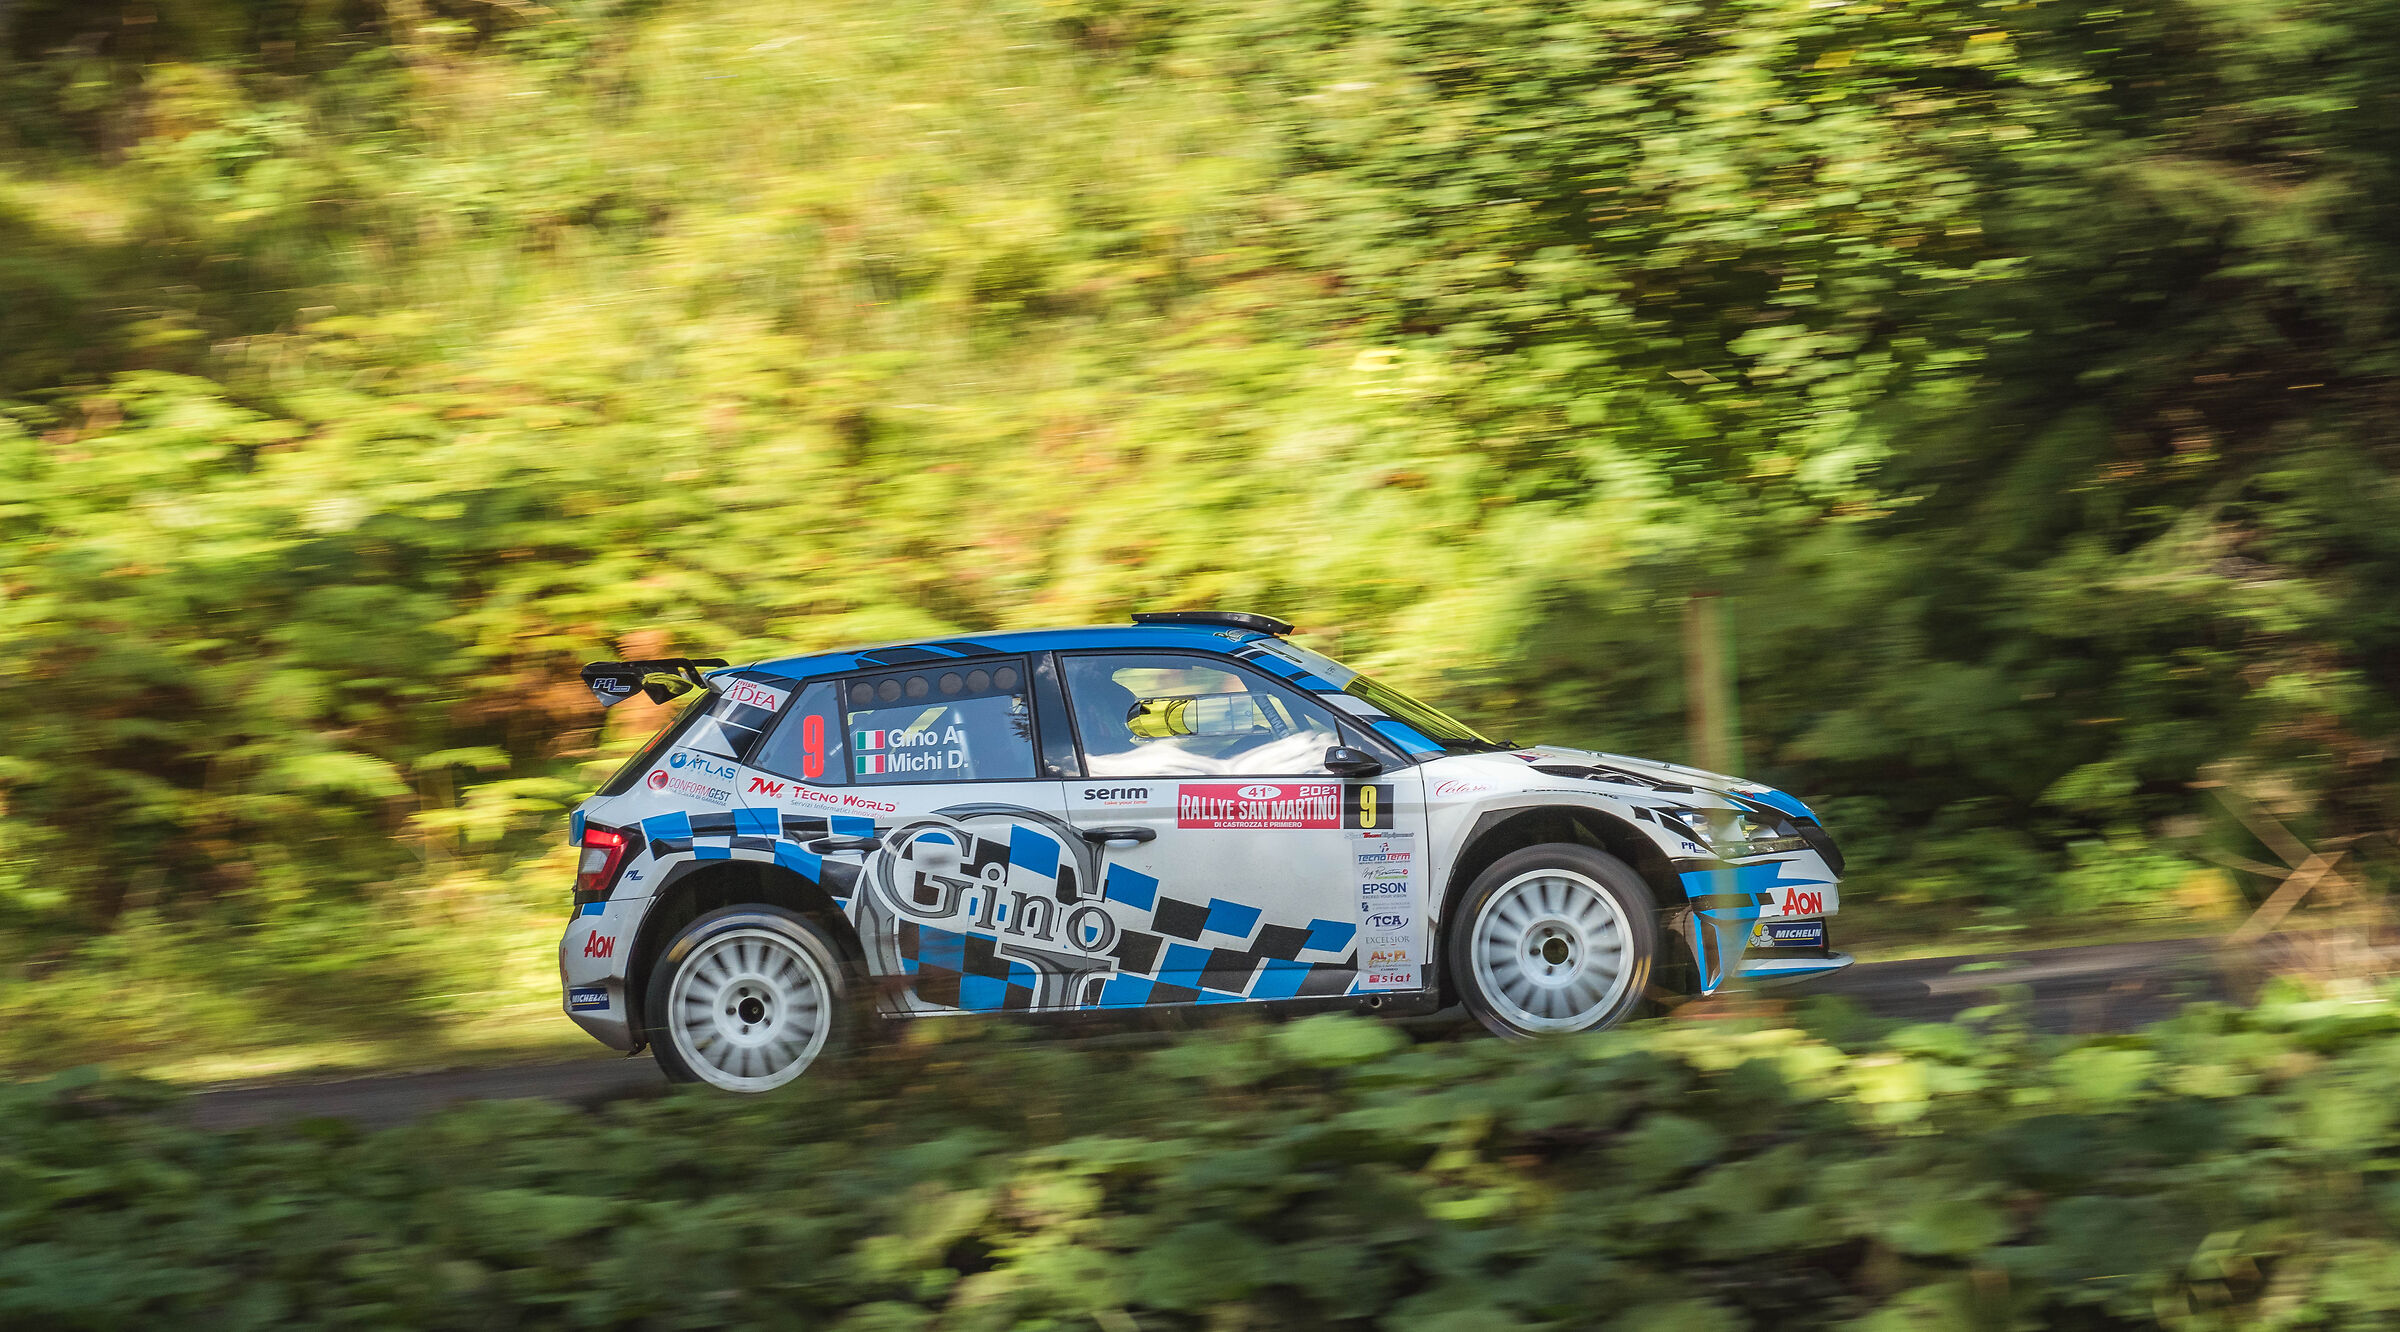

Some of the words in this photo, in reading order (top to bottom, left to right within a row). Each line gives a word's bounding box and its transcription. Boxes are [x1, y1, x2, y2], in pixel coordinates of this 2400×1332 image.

[730, 685, 775, 711] IDEA
[803, 715, 825, 778] 9
[888, 728, 939, 748] Gino
[686, 758, 737, 780] ATLAS
[888, 750, 943, 773] Michi
[947, 749, 969, 769] D.
[668, 776, 732, 802] CONFORMGEST
[1083, 787, 1149, 801] serim
[1299, 785, 1337, 797] 2021
[790, 799, 813, 809] Servizi
[813, 803, 851, 814] Informatici
[1180, 794, 1235, 821] RALLYE
[1238, 800, 1270, 821] SAN
[1271, 794, 1337, 821] MARTINO
[1359, 785, 1377, 829] 9
[1222, 821, 1263, 829] CASTROZZA
[876, 818, 1117, 954] Gino
[1362, 882, 1407, 895] EPSON
[1373, 915, 1402, 928] TCA
[1365, 935, 1410, 944] EXCELSIOR
[1775, 928, 1822, 939] MICHELIN
[1382, 972, 1411, 983] siat
